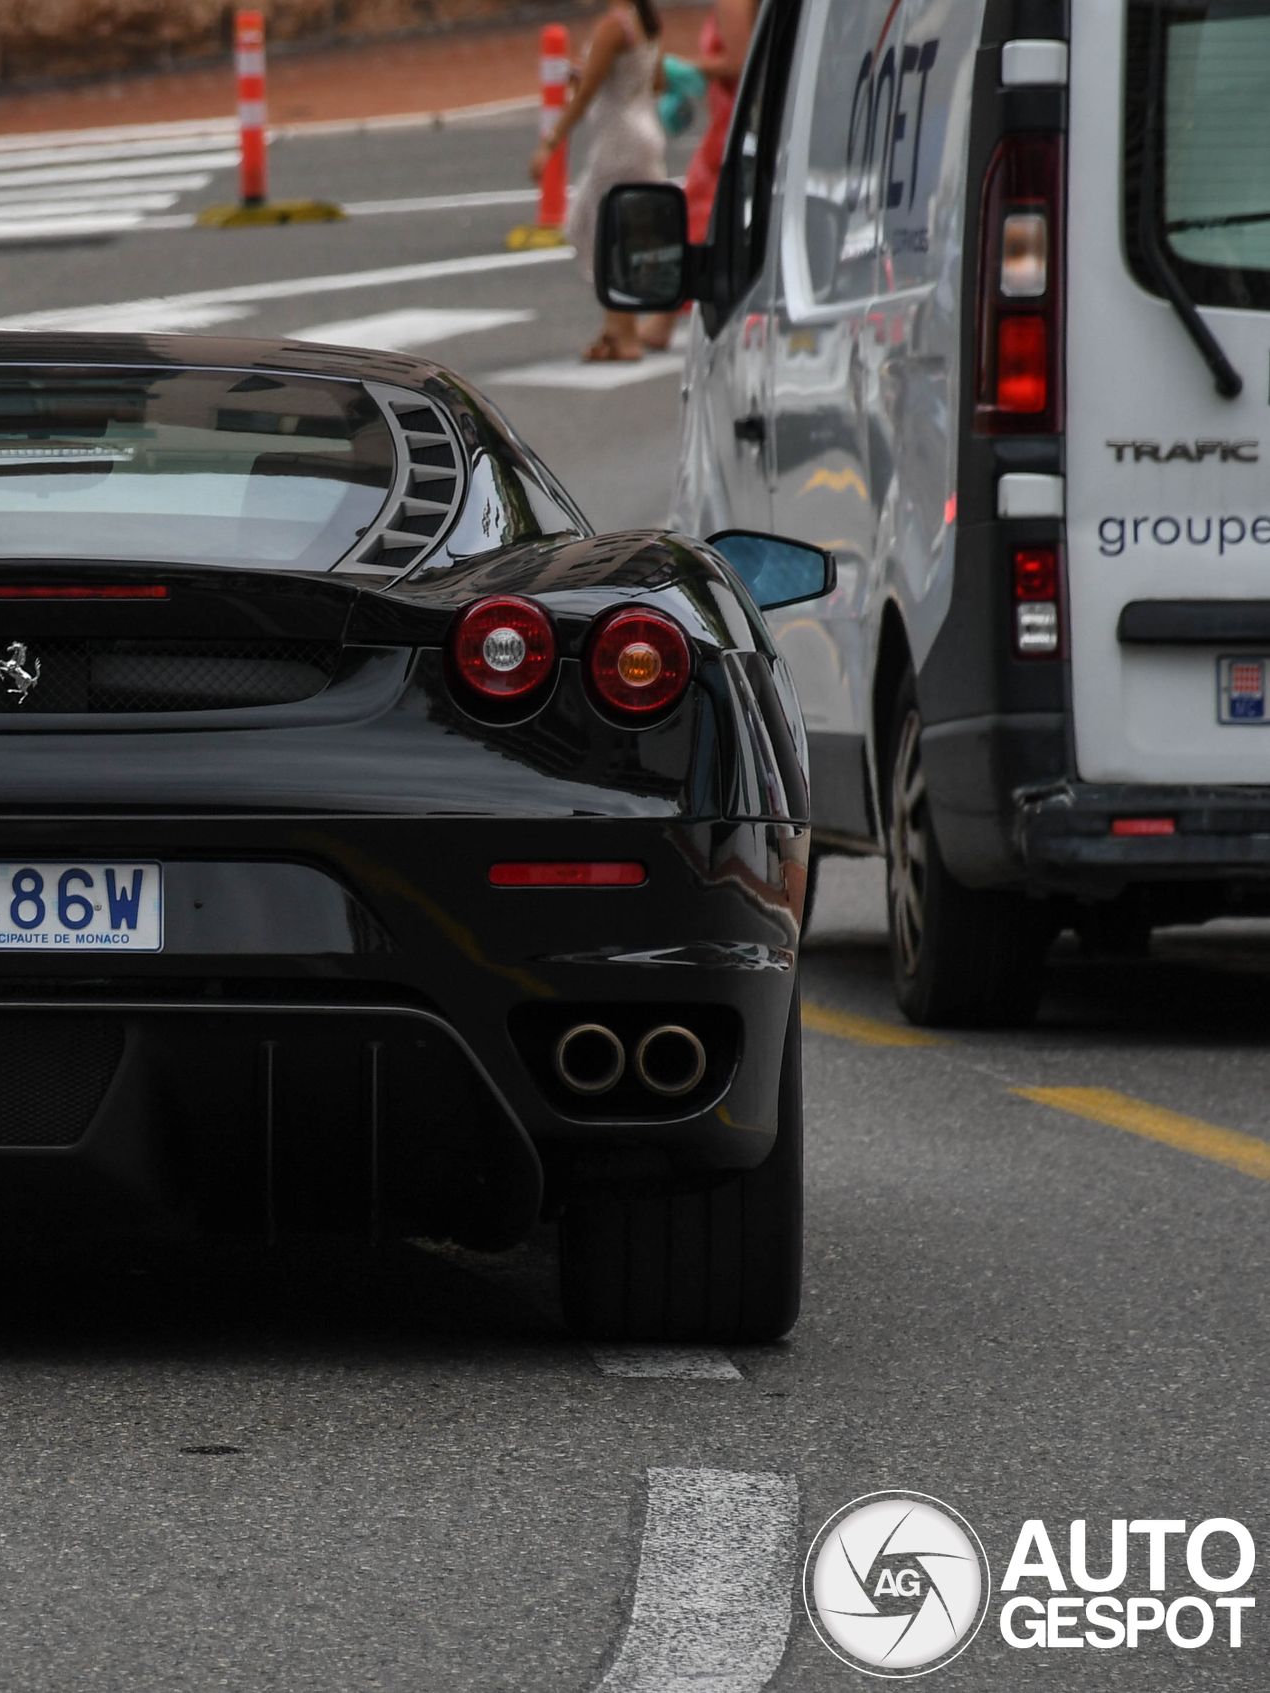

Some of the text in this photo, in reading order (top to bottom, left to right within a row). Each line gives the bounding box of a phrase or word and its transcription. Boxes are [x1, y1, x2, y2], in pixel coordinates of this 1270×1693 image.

[1105, 439, 1260, 463] TRAFIC
[1098, 515, 1270, 557] groupe
[54, 933, 70, 944] DE
[75, 933, 130, 944] MONACO
